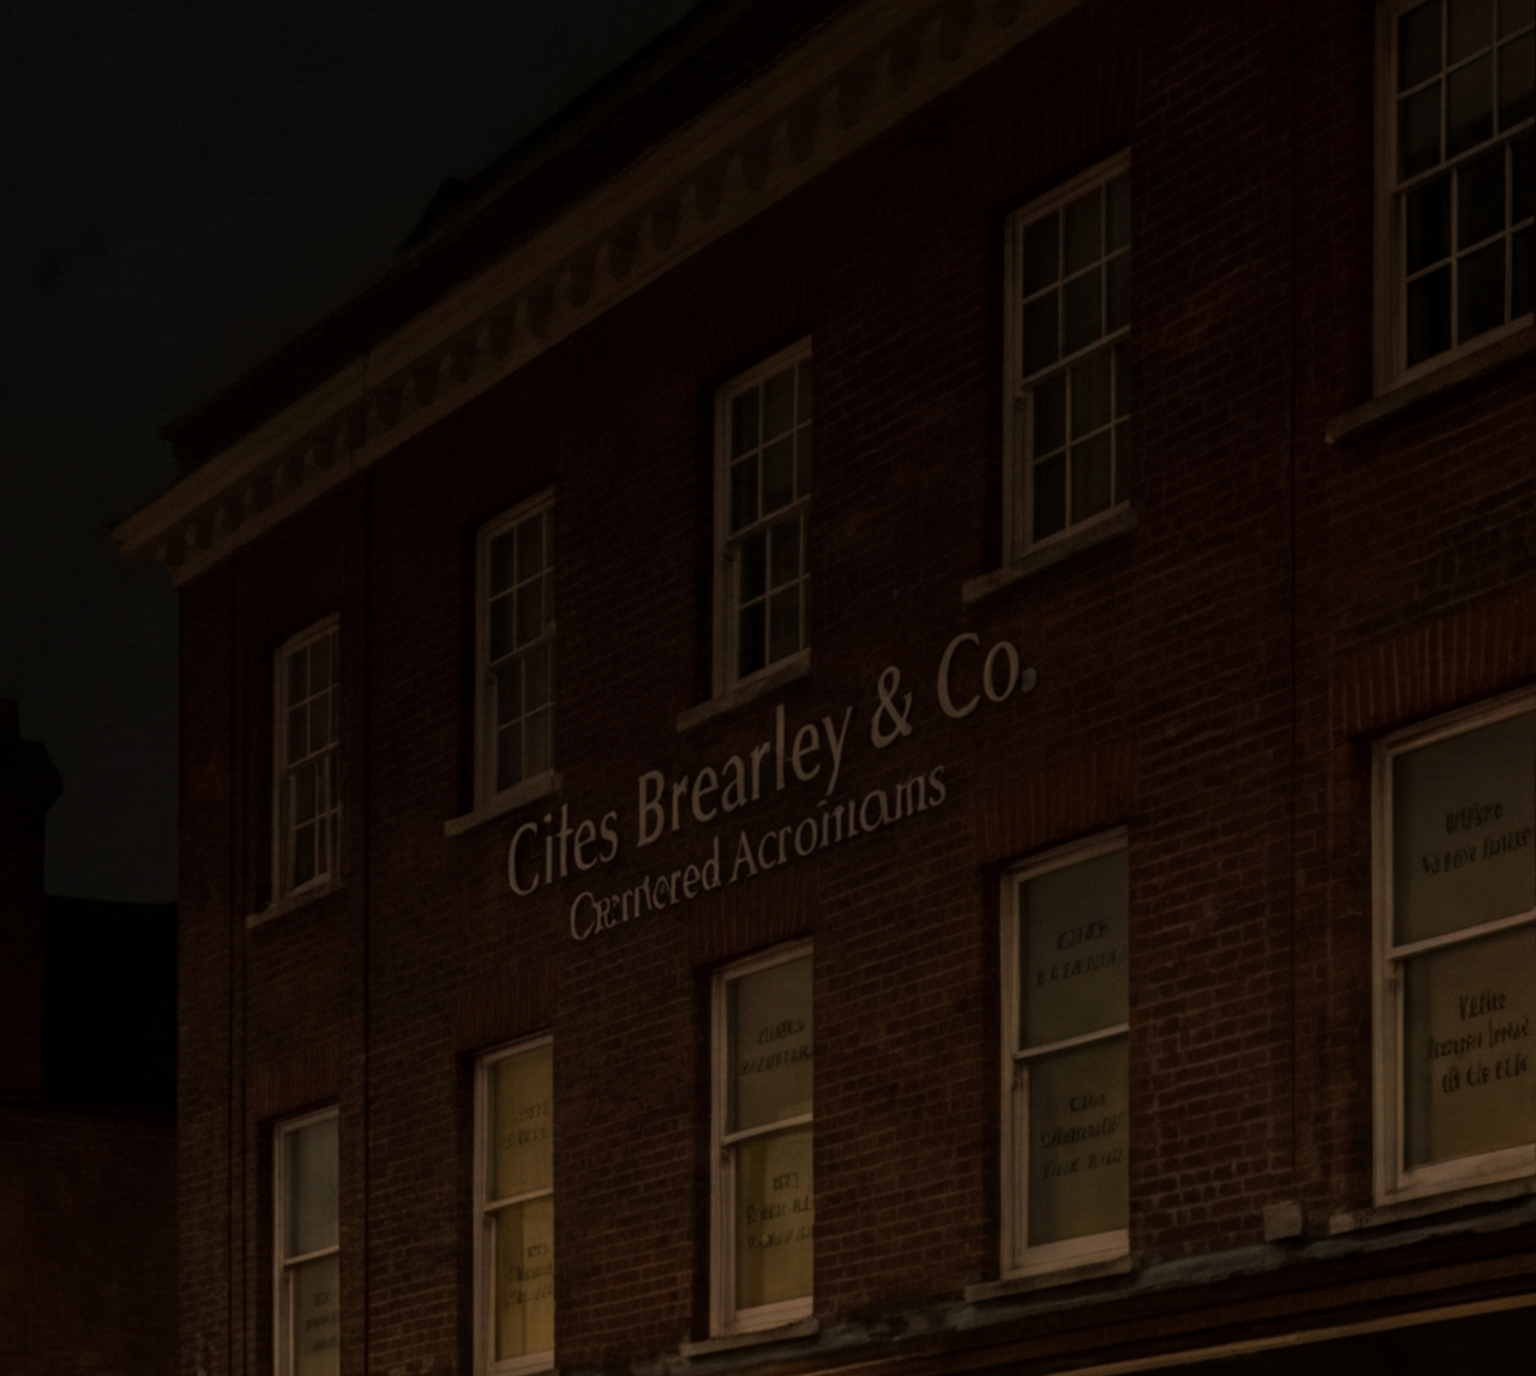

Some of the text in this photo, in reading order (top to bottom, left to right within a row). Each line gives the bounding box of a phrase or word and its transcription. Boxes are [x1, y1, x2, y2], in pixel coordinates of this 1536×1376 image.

[507, 632, 1038, 897] Cites Brearley & Co.
